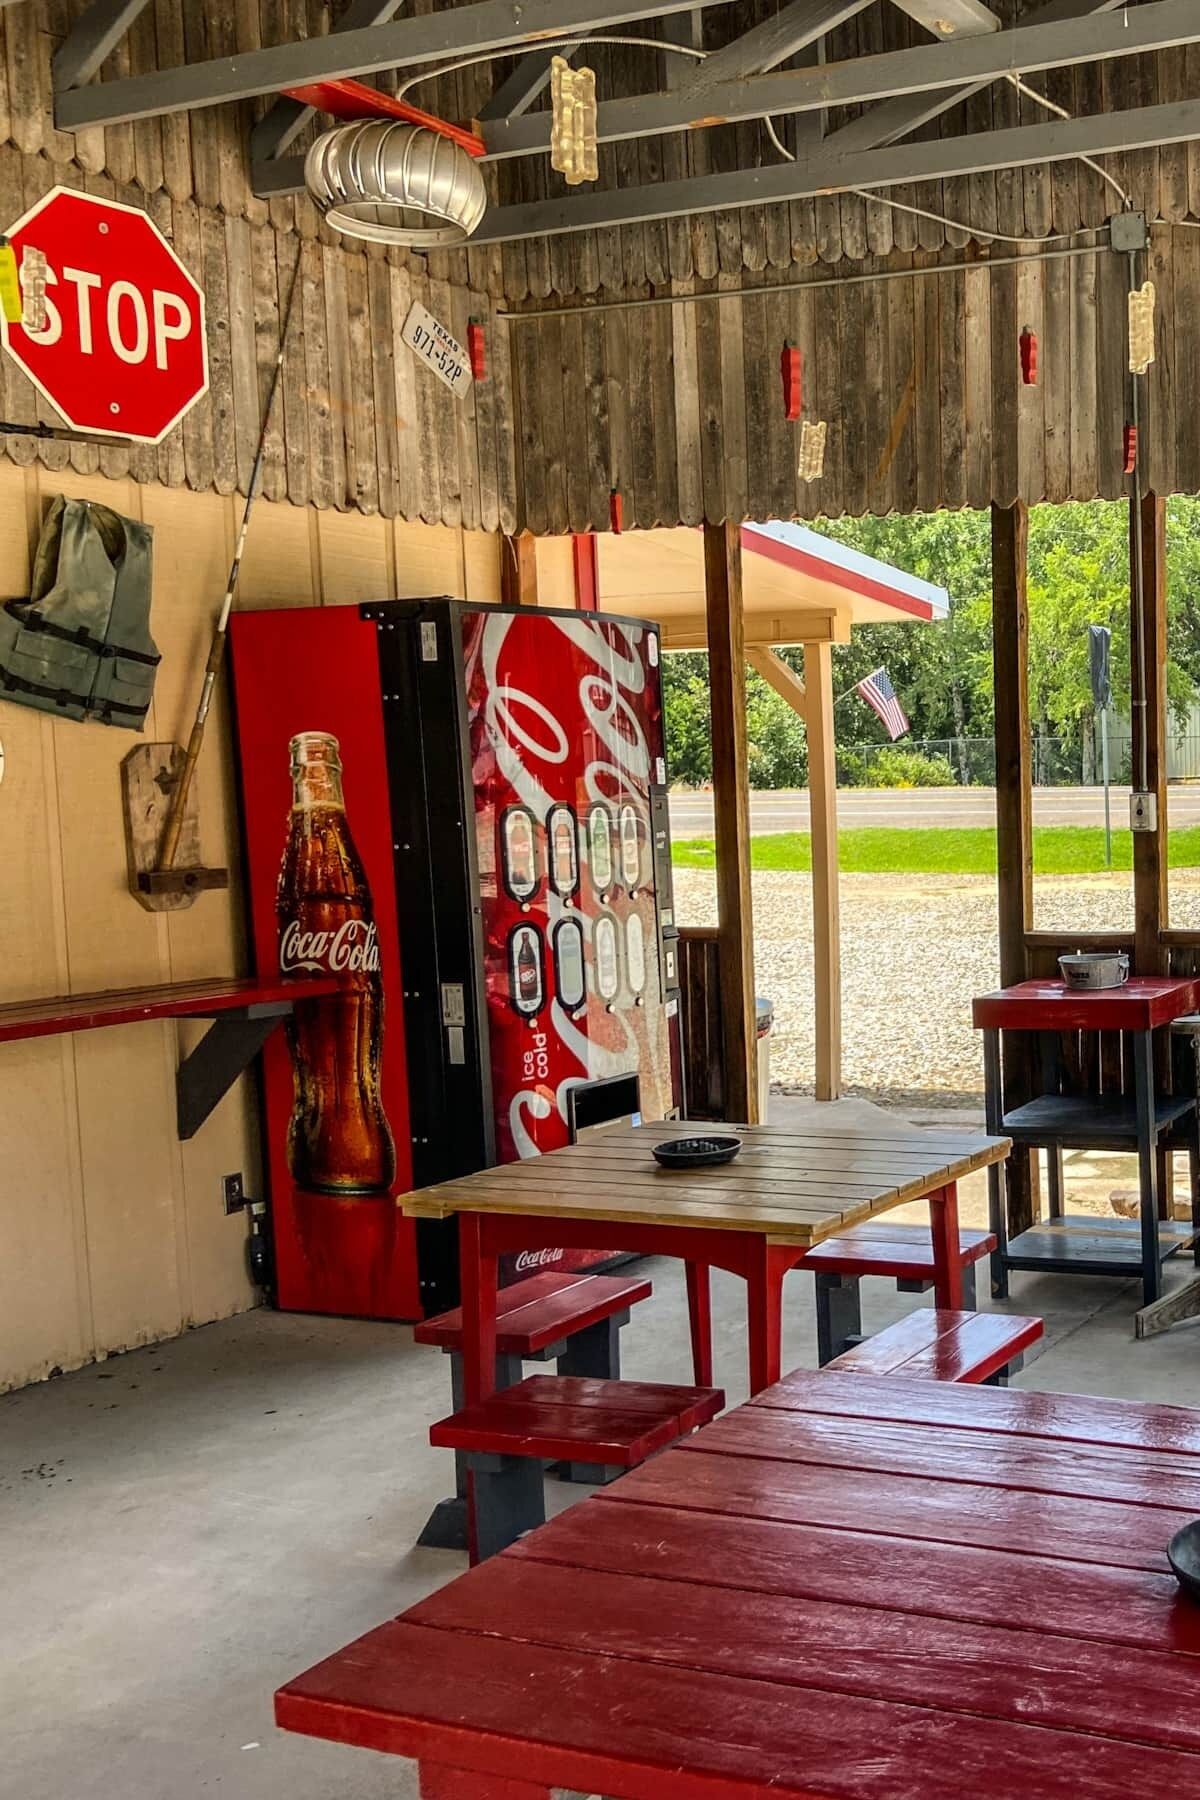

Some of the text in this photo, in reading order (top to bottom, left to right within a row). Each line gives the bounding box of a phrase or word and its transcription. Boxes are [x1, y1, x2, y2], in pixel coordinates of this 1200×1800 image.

[19, 262, 192, 370] STOP
[432, 321, 459, 352] TEXAS
[280, 919, 381, 972] Coca-Cola
[521, 1051, 535, 1081] ice
[531, 1032, 548, 1078] cold
[515, 1247, 564, 1272] Coca-Cola
